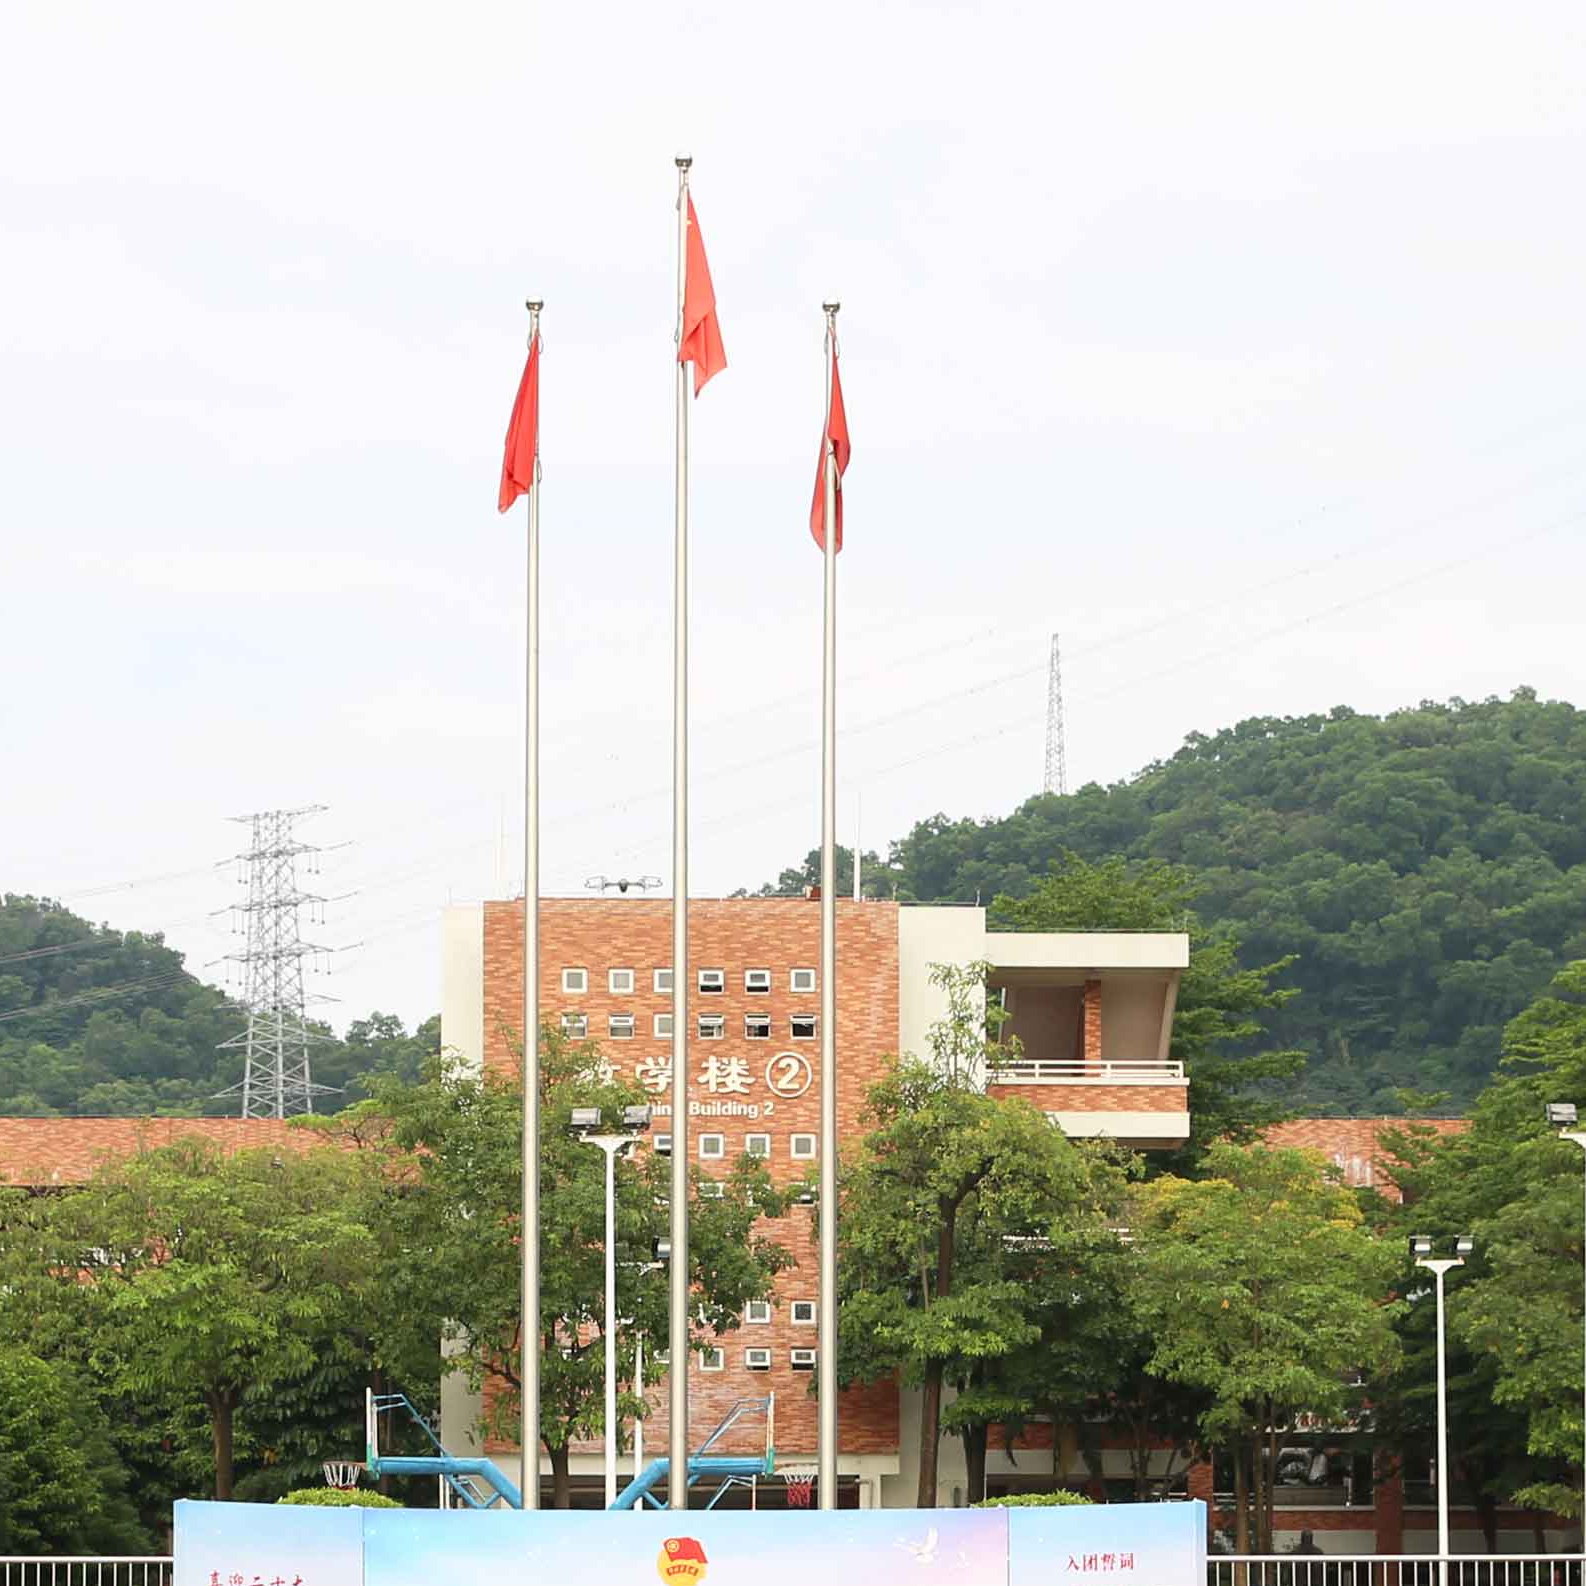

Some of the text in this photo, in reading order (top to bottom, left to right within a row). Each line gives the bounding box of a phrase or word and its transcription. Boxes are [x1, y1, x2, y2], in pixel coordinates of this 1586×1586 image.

[689, 1102, 759, 1119] Building
[763, 1102, 774, 1116] 2
[1068, 1553, 1134, 1572] 入团誓词
